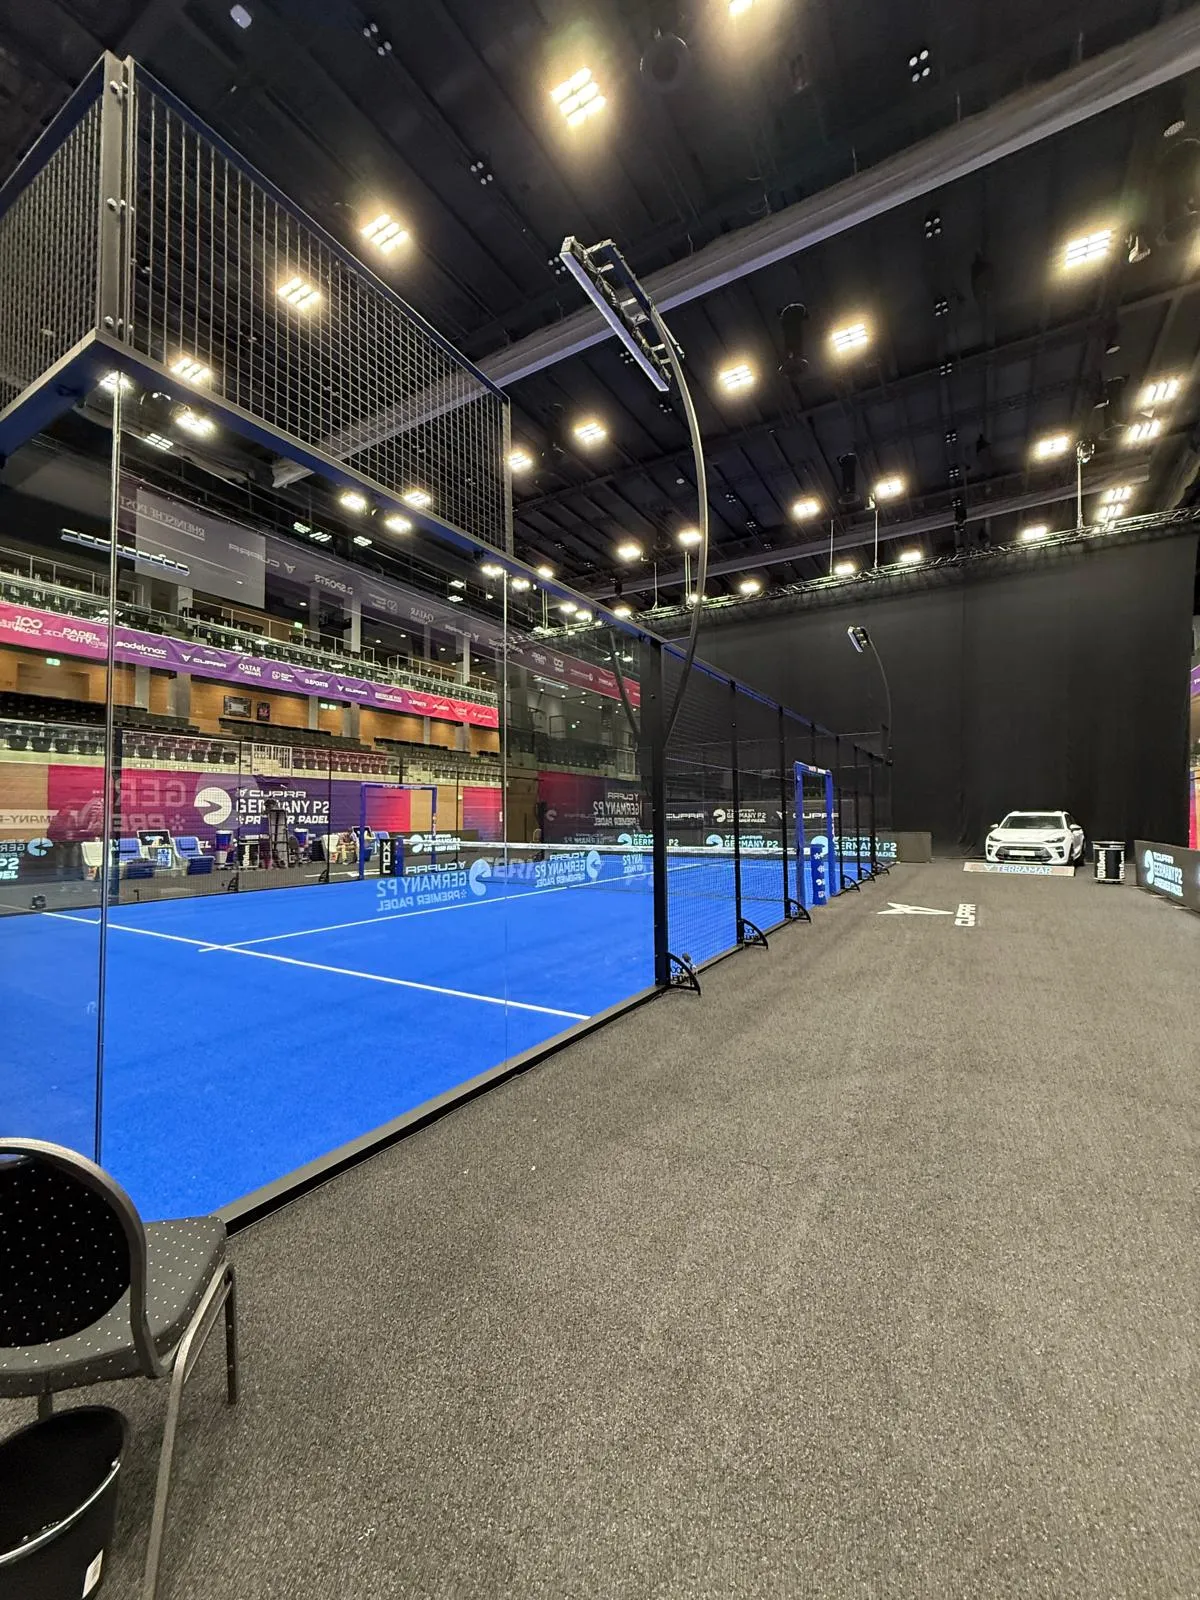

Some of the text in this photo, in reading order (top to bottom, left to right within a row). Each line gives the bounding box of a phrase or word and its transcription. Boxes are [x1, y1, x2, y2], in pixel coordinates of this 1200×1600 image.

[193, 657, 227, 668] CUPRA
[238, 663, 261, 674] QATAR
[250, 790, 307, 798] CUPRA
[236, 799, 330, 814] GERANY P2
[298, 815, 329, 824] PADEL
[766, 841, 779, 849] P2
[883, 842, 897, 852] P2
[1097, 850, 1106, 878] Wilson
[996, 865, 1053, 875] TERRAMAR
